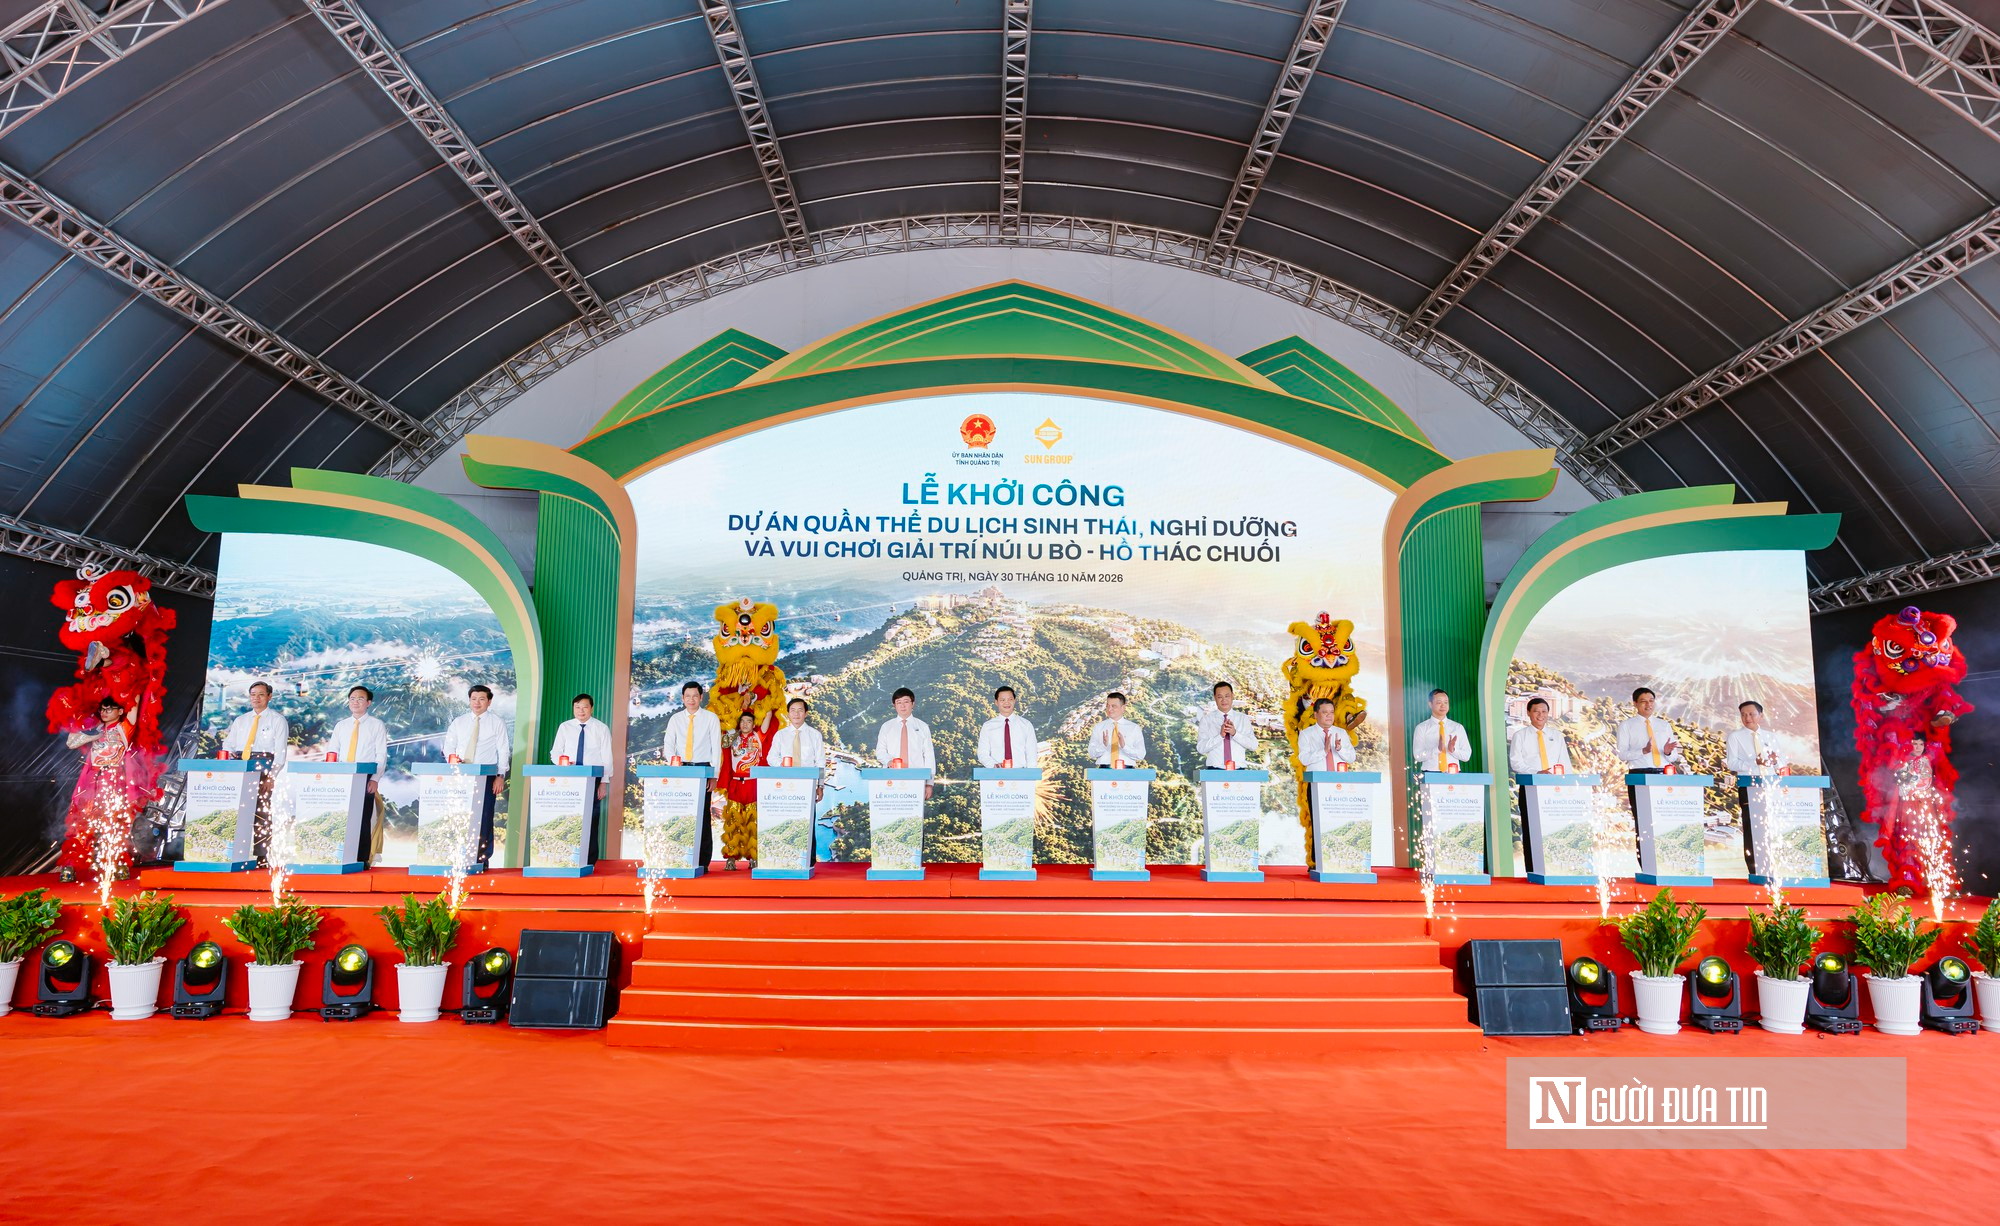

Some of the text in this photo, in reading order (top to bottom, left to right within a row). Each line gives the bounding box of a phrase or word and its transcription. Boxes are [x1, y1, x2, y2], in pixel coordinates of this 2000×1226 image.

[1024, 454, 1072, 464] SUN GROUP
[902, 472, 1124, 506] LỄ KHỞI CÔNG
[728, 508, 1297, 538] DỰ ÁN QUẦN THỂ DU LỊCH SINH THÁI, NGHỈ DƯỠNG
[744, 537, 775, 557] VÀ
[780, 541, 818, 557] VUI
[824, 540, 881, 558] CHƠI
[887, 538, 934, 559] GIẢI
[940, 539, 976, 559] TRÍ
[982, 540, 1021, 559] NÚI
[1028, 543, 1042, 560] U
[1049, 540, 1082, 560] BÒ
[1099, 538, 1132, 560] HỒ
[1138, 540, 1200, 561] THÁC
[1206, 539, 1280, 562] CHUỐI
[902, 570, 1124, 583] QUẢNG TRỊ, NGÀY 30 THÁNG 10 NĂM 2026
